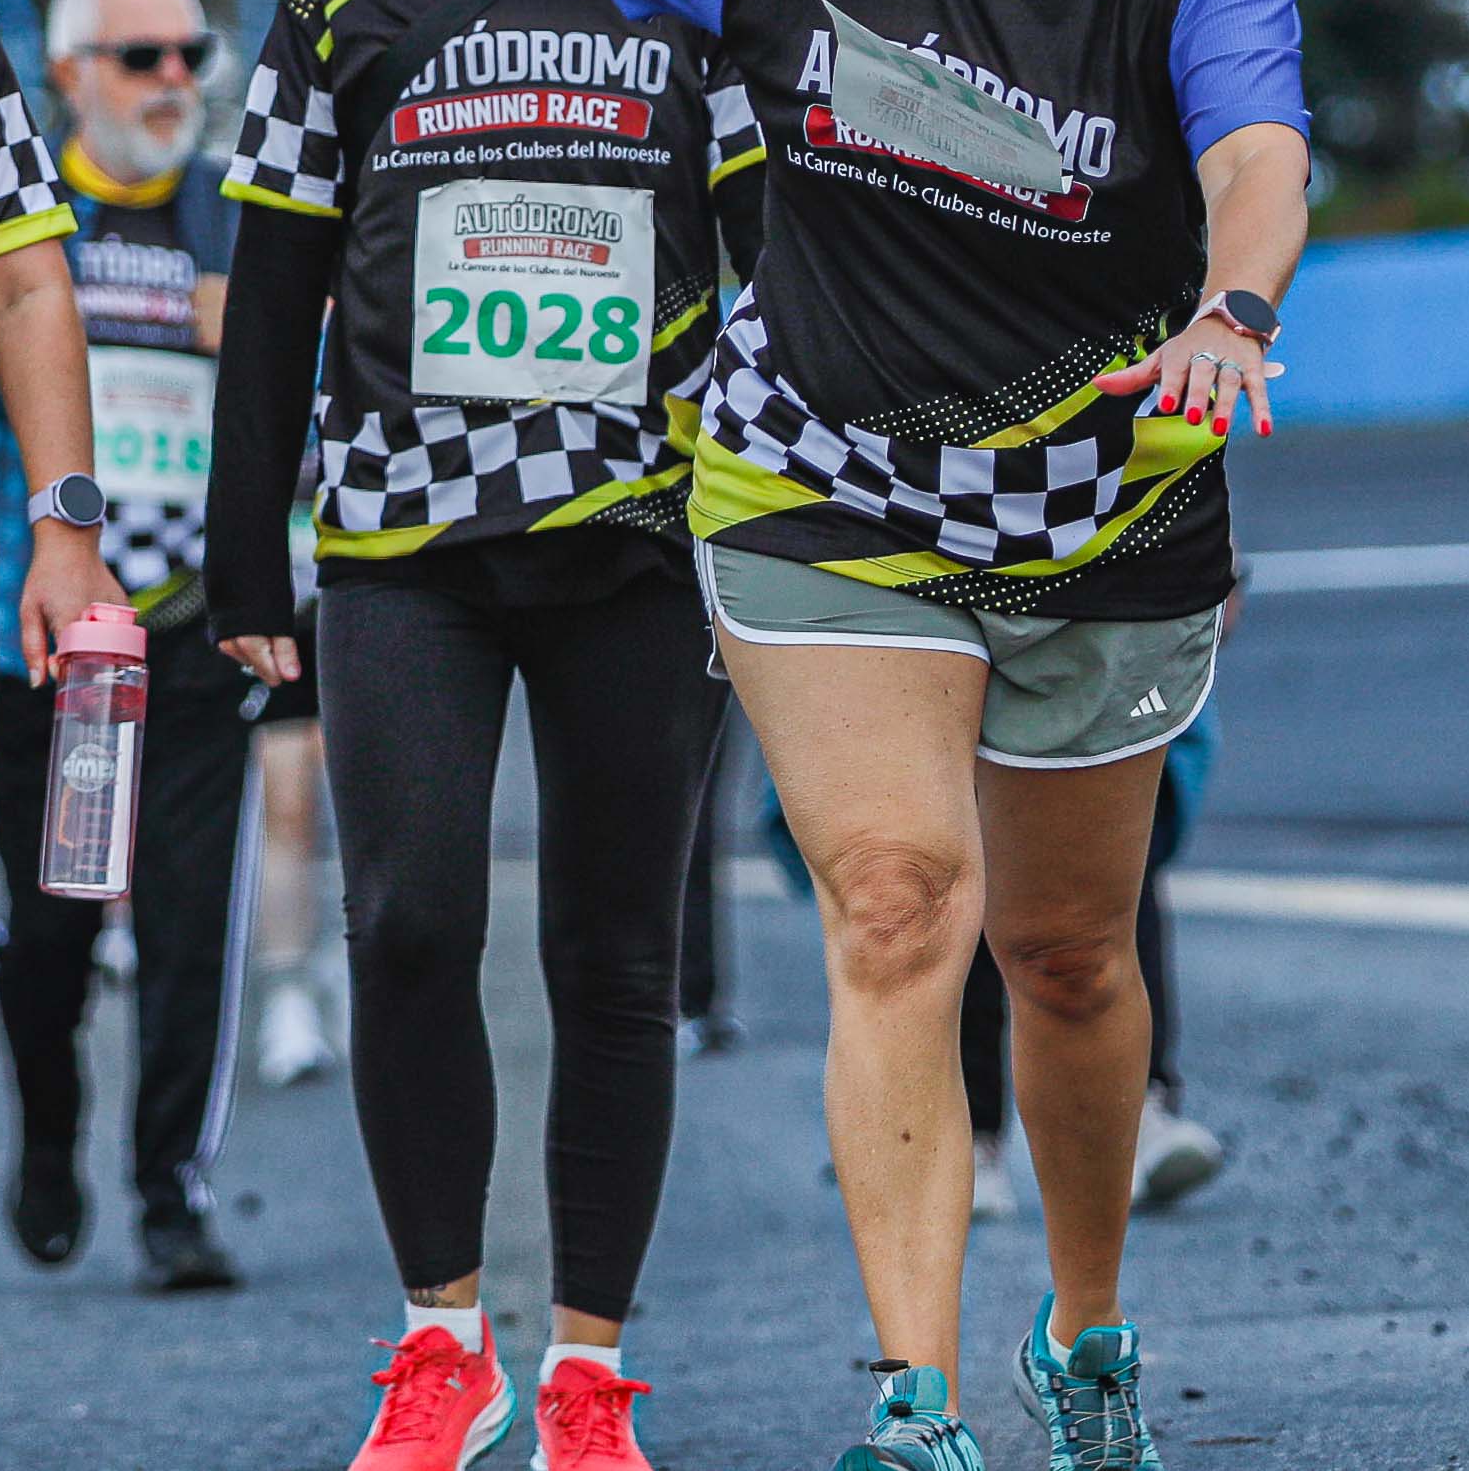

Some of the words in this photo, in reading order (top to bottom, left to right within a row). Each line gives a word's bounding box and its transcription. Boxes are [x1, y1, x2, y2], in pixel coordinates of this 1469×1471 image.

[399, 19, 672, 100] UTÓDROMO
[416, 92, 539, 137] RUNNING
[547, 93, 622, 131] RACE
[372, 154, 388, 172] La
[390, 148, 451, 168] Carrera
[453, 145, 476, 165] de
[478, 143, 504, 163] los
[506, 141, 564, 161] Clubes
[569, 140, 595, 159] del
[597, 140, 672, 165] Noroeste
[455, 193, 623, 243] AUTÓDROMO
[786, 144, 802, 166] La
[804, 152, 863, 181] Carrera
[867, 168, 888, 188] de
[893, 173, 918, 197] los
[921, 187, 984, 220] Clubes
[988, 209, 1017, 231] del
[1022, 218, 1112, 244] Noroeste
[481, 237, 549, 256] RUNNING
[552, 240, 595, 261] RACE
[422, 287, 641, 365] 2028
[95, 424, 207, 474] 018
